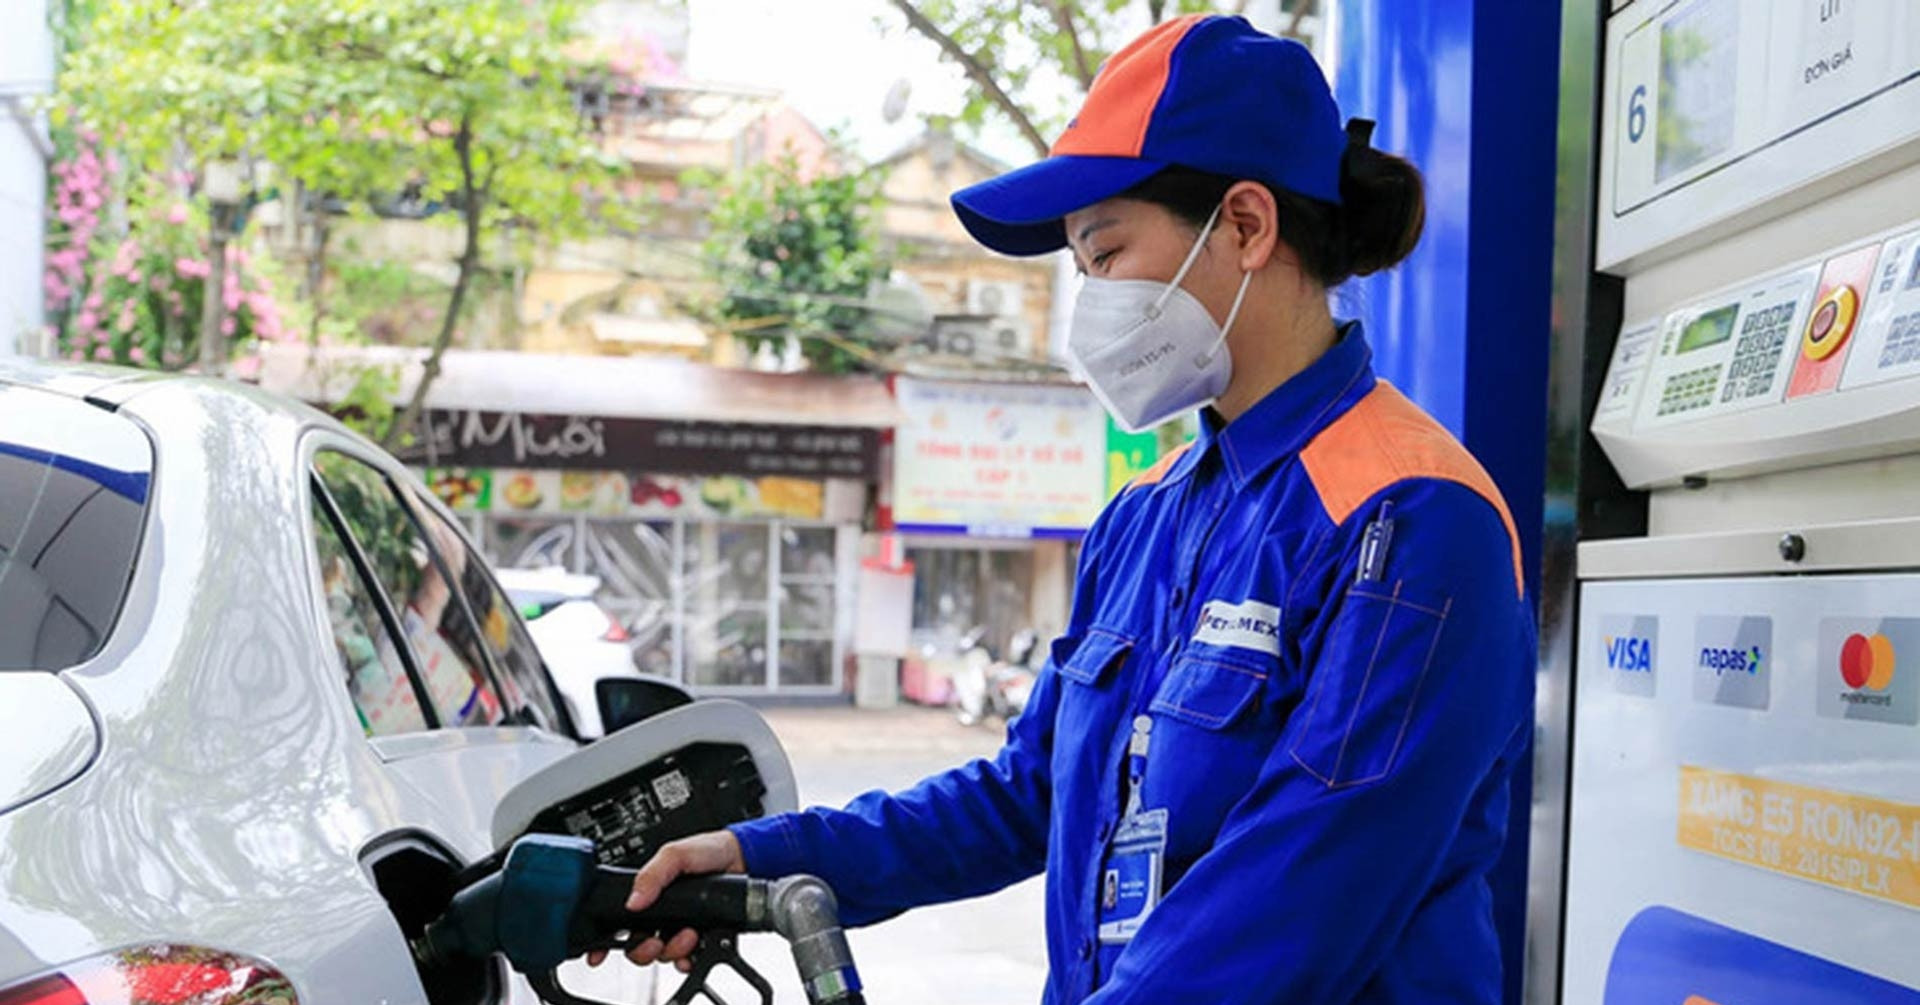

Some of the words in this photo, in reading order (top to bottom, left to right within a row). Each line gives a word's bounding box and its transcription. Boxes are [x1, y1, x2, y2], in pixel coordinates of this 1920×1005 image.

[1627, 84, 1646, 143] 6
[1604, 636, 1652, 673] VISA
[1700, 646, 1748, 676] napas
[1762, 792, 1795, 836] E5
